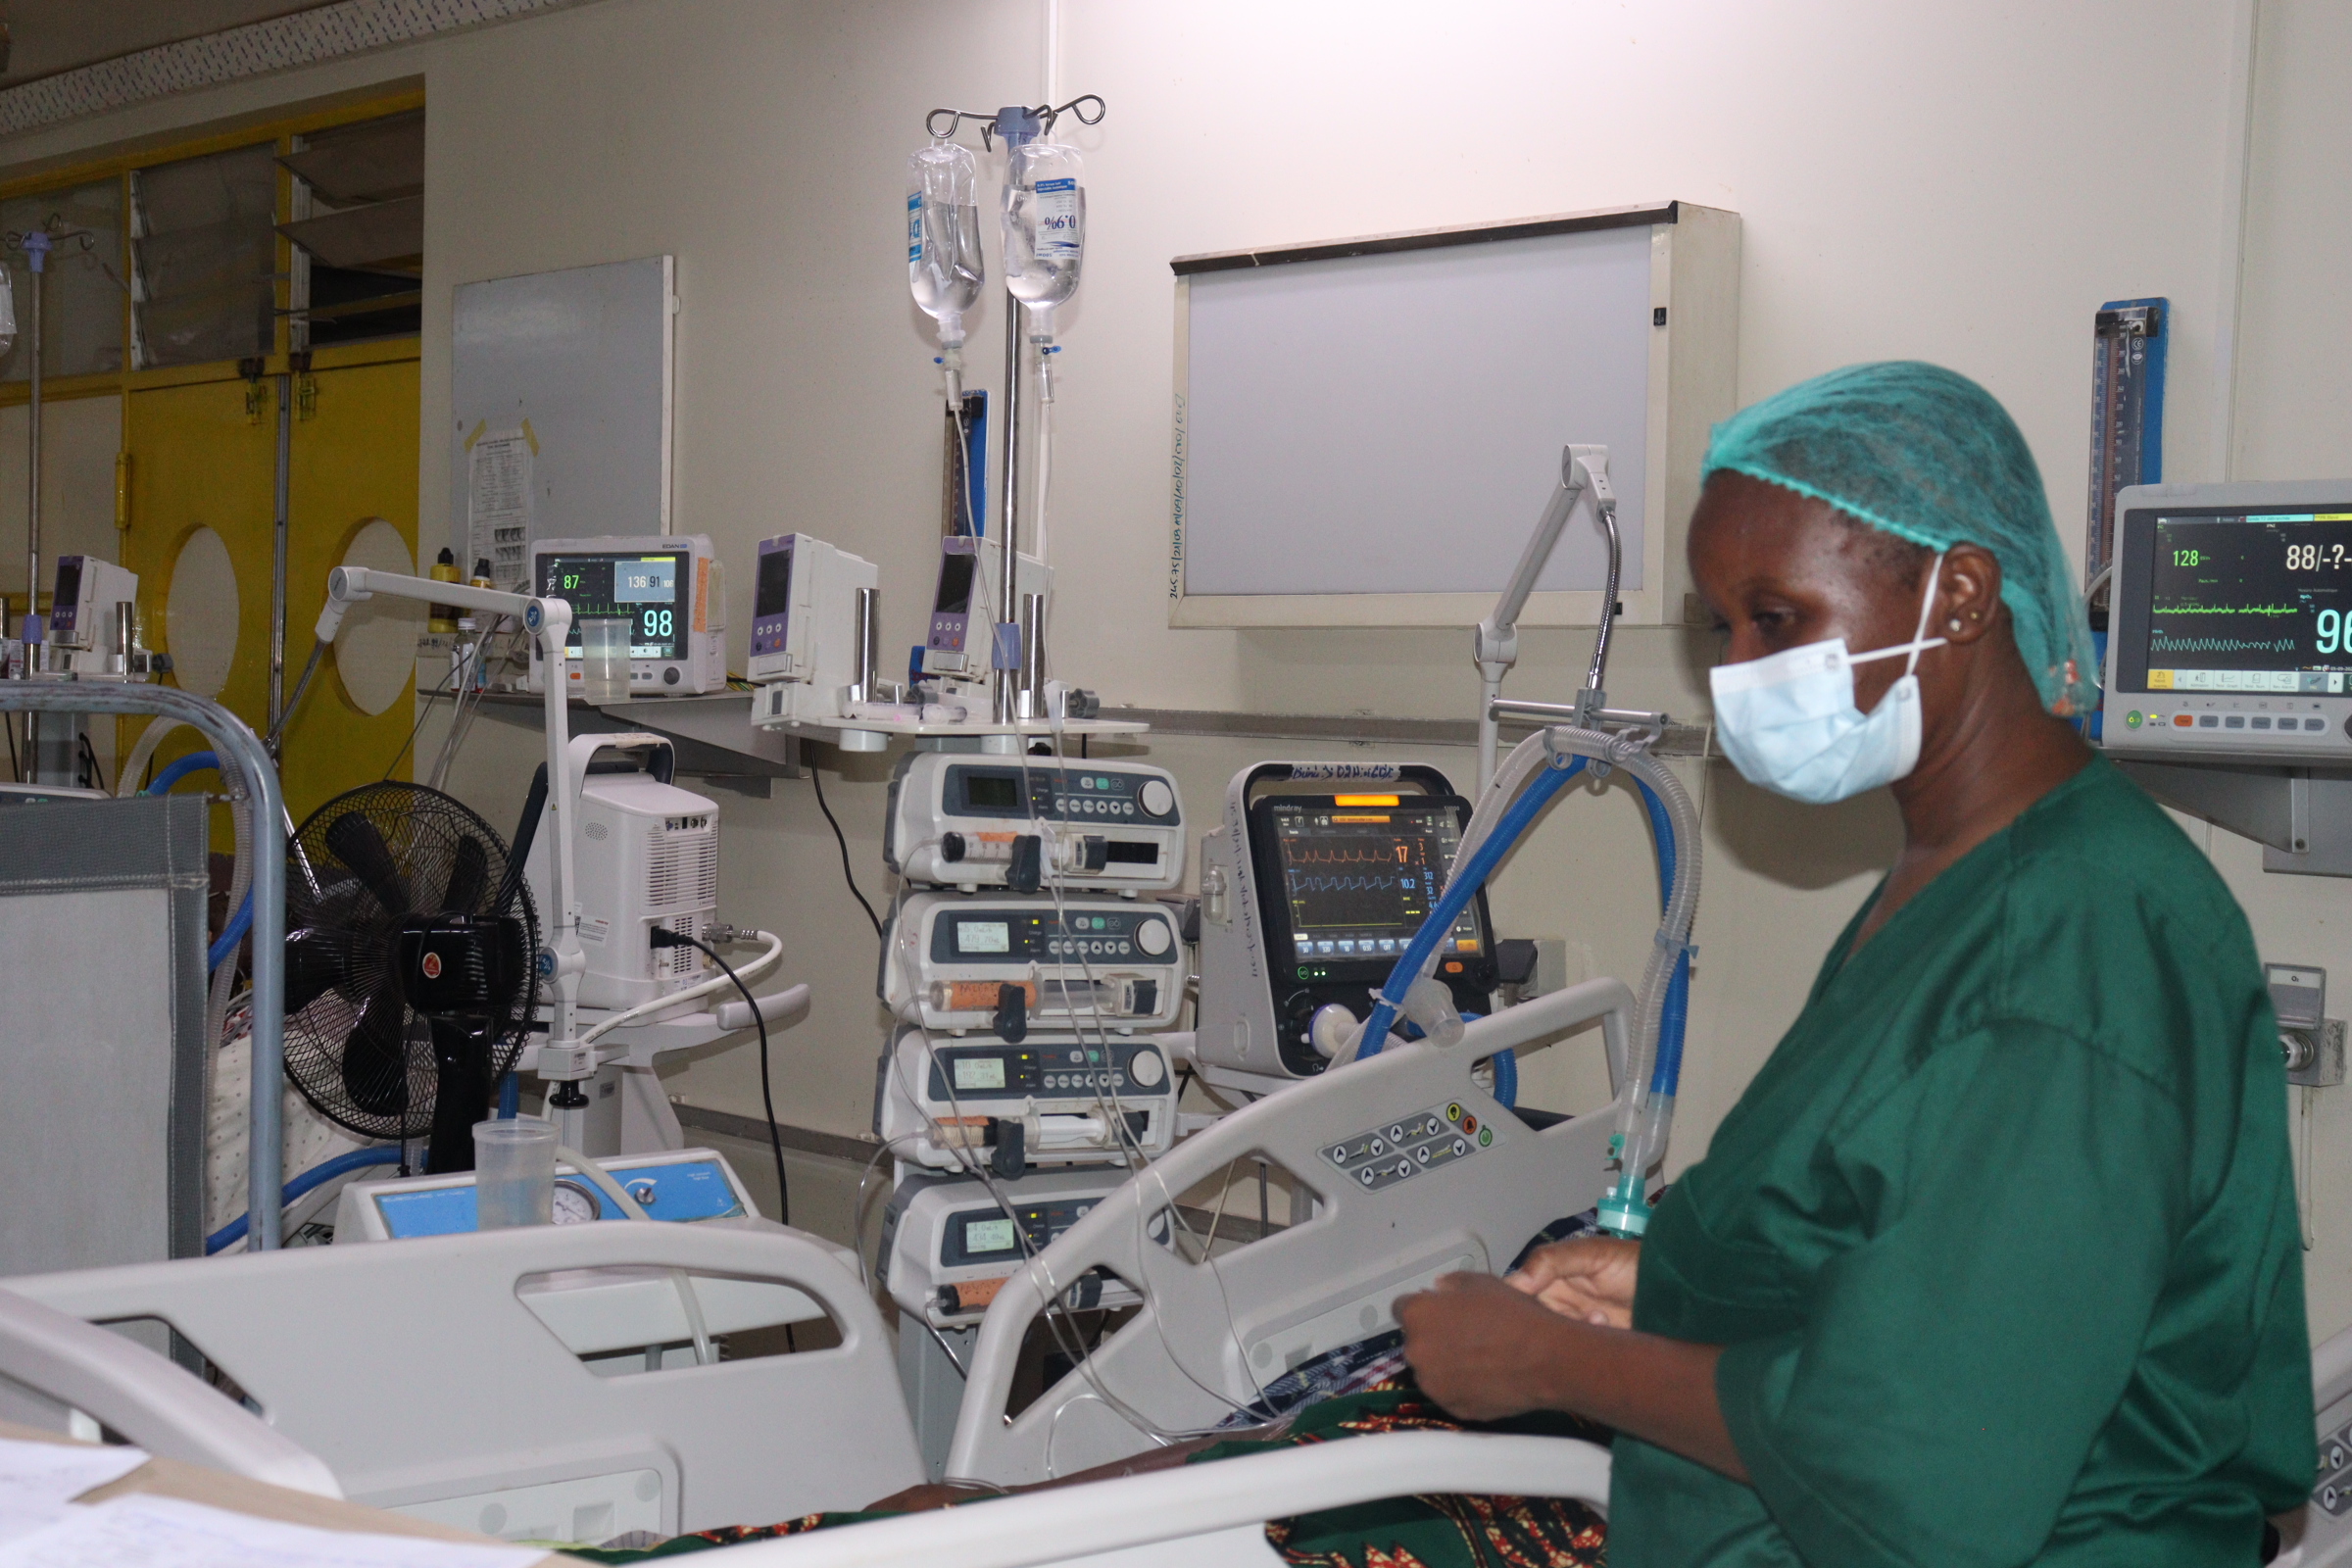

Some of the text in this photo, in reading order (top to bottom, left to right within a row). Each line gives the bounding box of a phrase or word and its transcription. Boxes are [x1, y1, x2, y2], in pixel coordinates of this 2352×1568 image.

[1045, 215, 1076, 230] 0.9%
[2173, 550, 2199, 566] 128
[564, 574, 579, 589] 87
[628, 575, 646, 588] 136
[649, 575, 660, 588] 91
[644, 610, 672, 637] 98
[1274, 805, 1302, 814] mindray
[1396, 846, 1408, 862] 17
[1400, 871, 1434, 889] 10.2 312
[1426, 886, 1434, 895] 32
